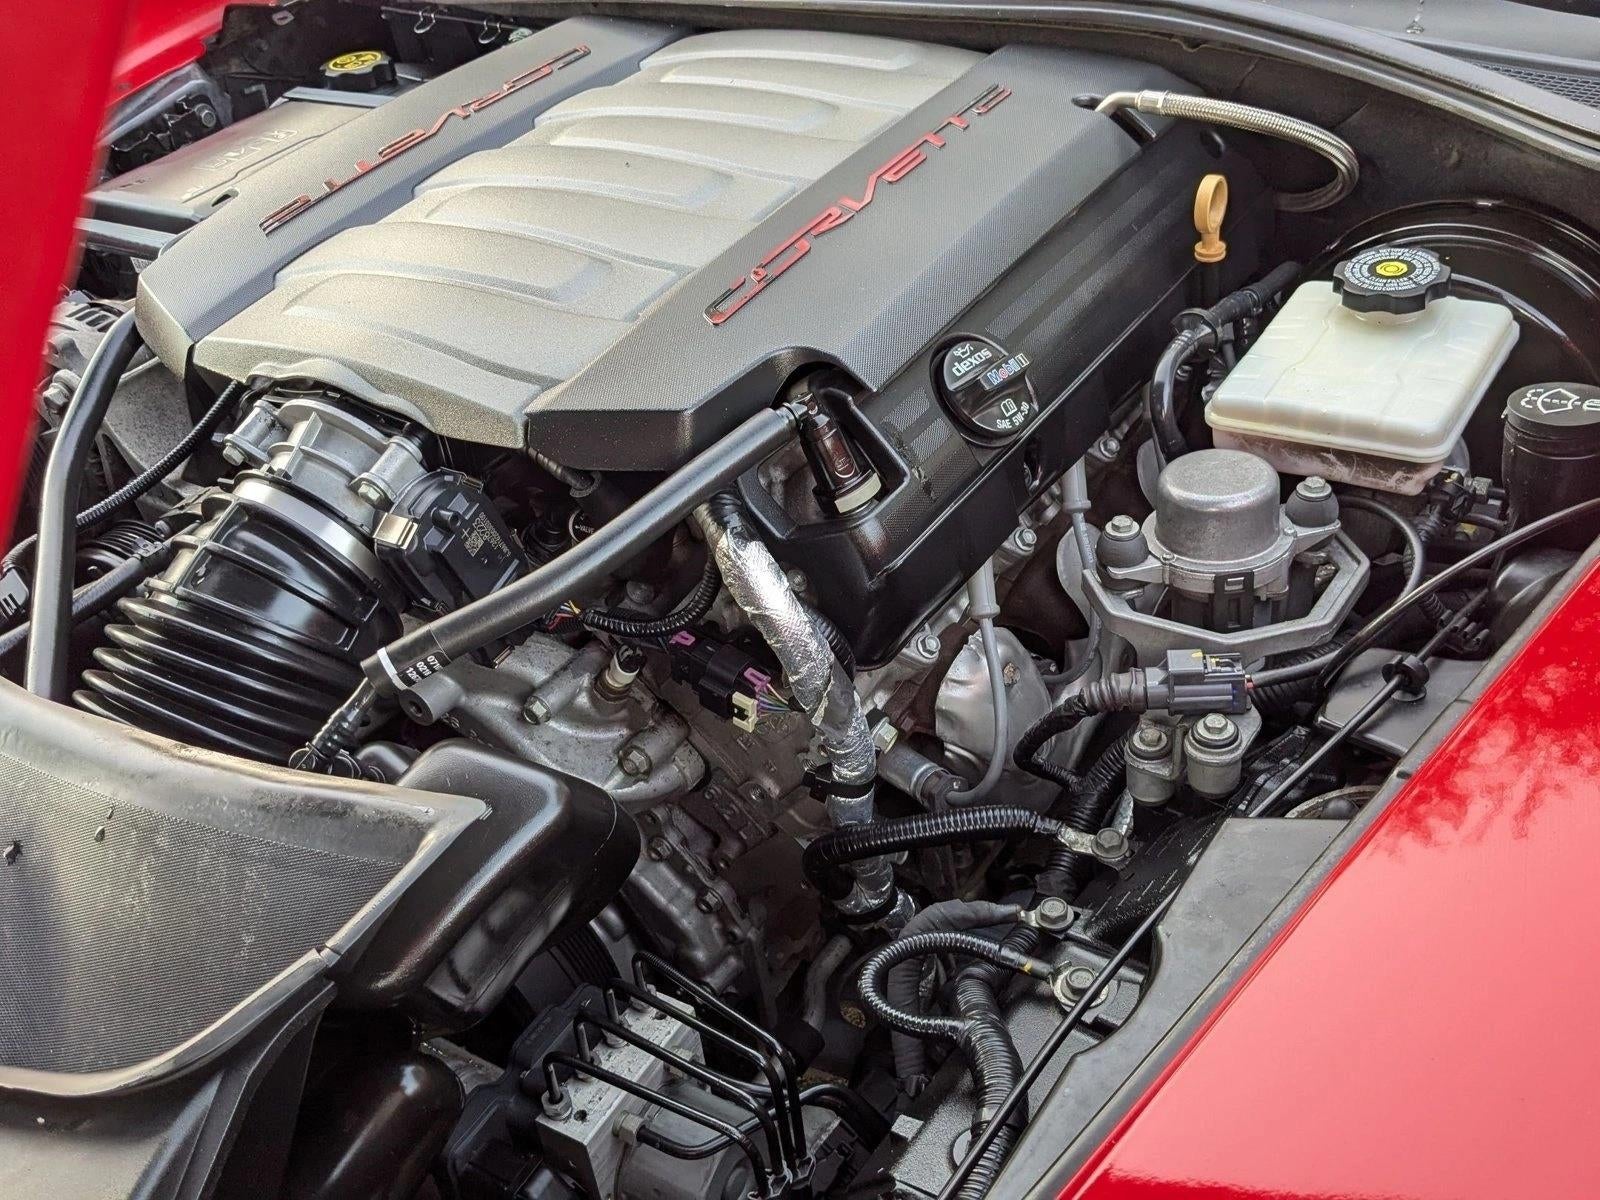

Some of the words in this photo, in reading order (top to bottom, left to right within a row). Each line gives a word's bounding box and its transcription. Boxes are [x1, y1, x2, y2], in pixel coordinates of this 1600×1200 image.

[259, 44, 591, 236] CORVETTE
[703, 84, 1012, 325] CORVETTE
[952, 348, 992, 377] dexos
[986, 358, 1021, 386] Mobil
[996, 419, 1013, 429] SAE
[1012, 401, 1030, 426] 5W-30
